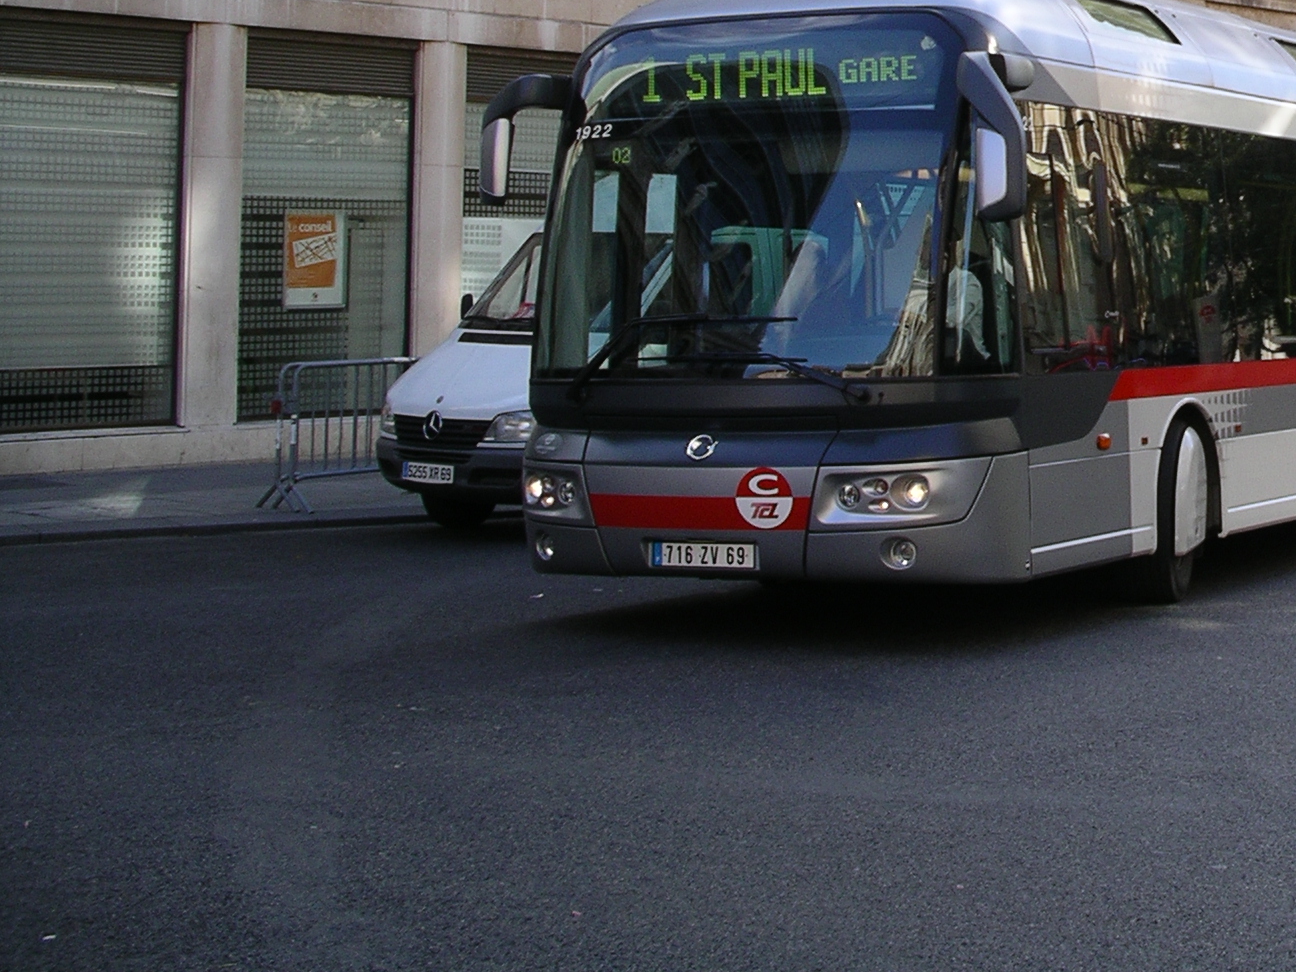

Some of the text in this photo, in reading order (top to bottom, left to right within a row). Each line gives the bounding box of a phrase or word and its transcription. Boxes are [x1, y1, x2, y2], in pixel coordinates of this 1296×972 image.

[643, 48, 917, 102] 1 ST PAUL GARE
[575, 124, 613, 140] 1922
[408, 465, 428, 479] 5255
[441, 468, 452, 481] 69
[748, 473, 780, 496] C
[666, 545, 746, 566] 716 ZV 69
